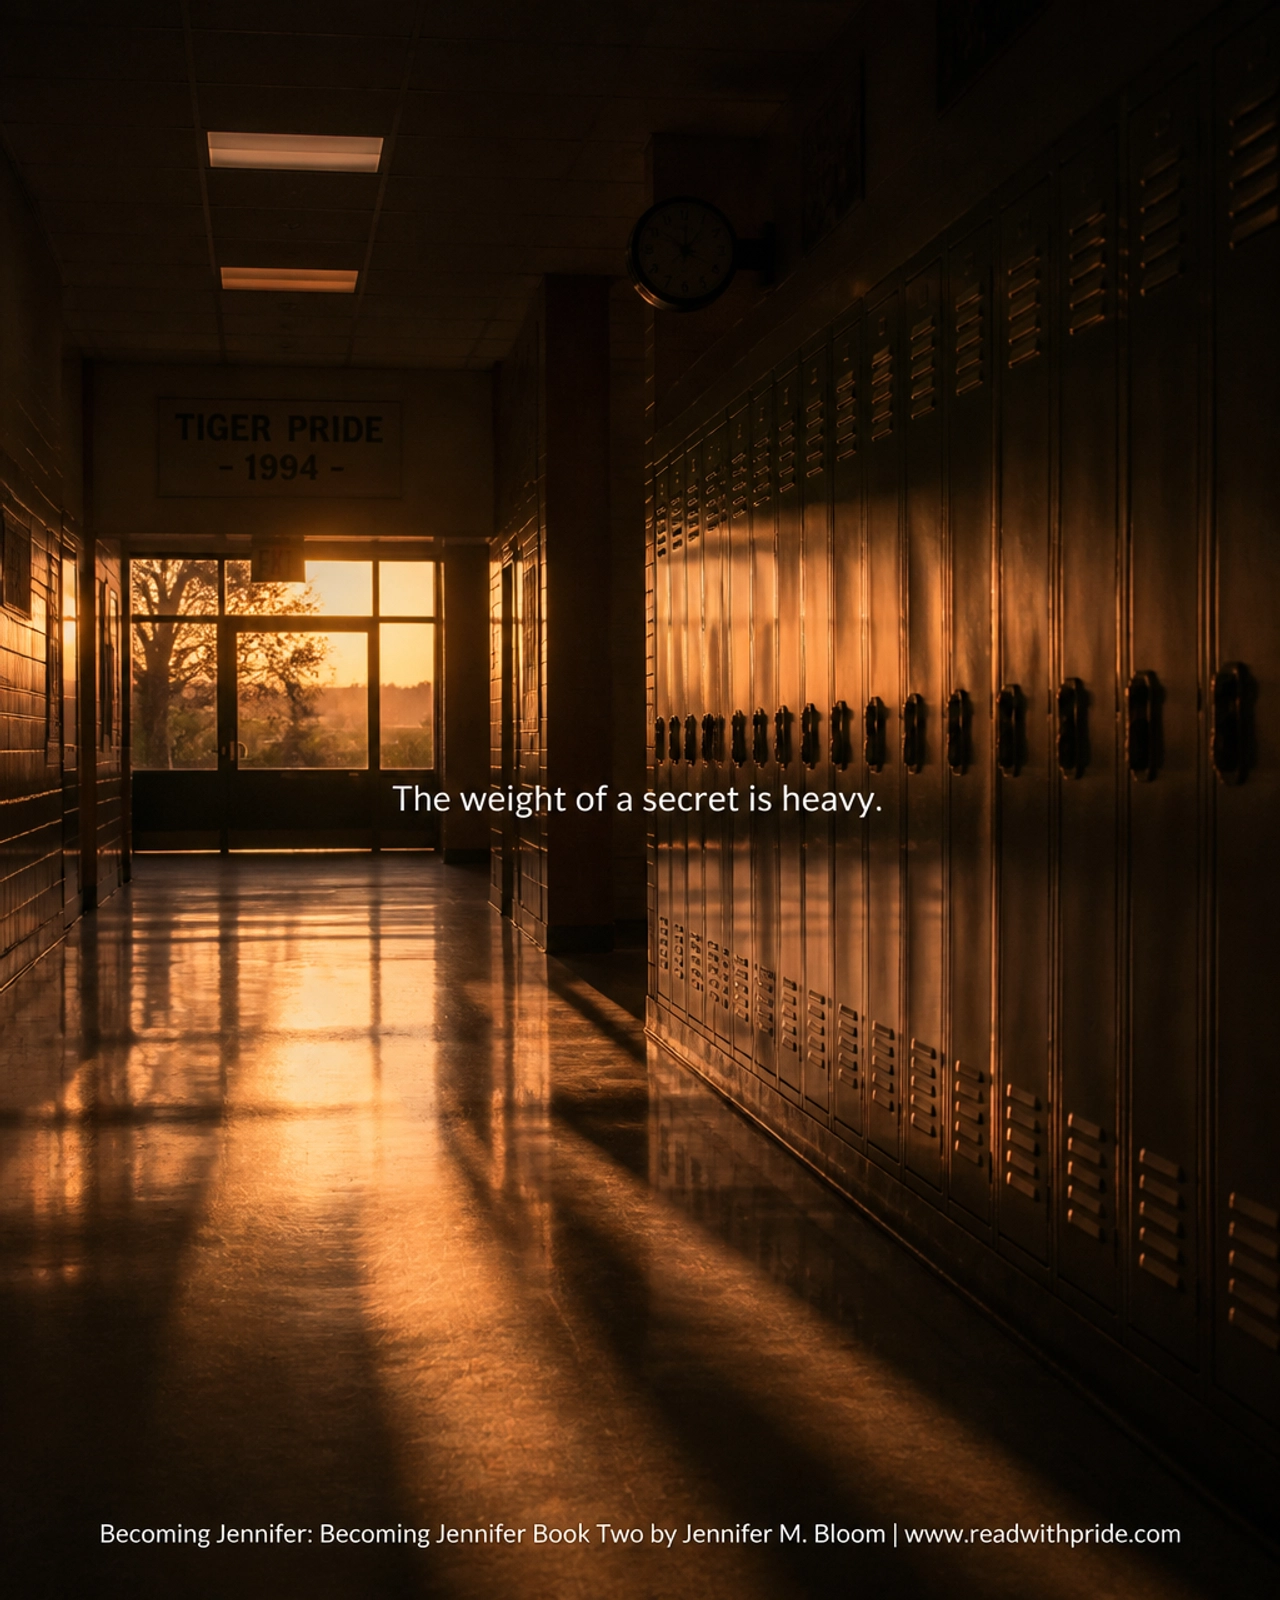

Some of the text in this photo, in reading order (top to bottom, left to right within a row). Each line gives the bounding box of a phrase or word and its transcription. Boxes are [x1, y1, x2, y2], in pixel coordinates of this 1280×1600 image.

[174, 413, 383, 443] TIGER PRIDE
[244, 453, 318, 480] 1994
